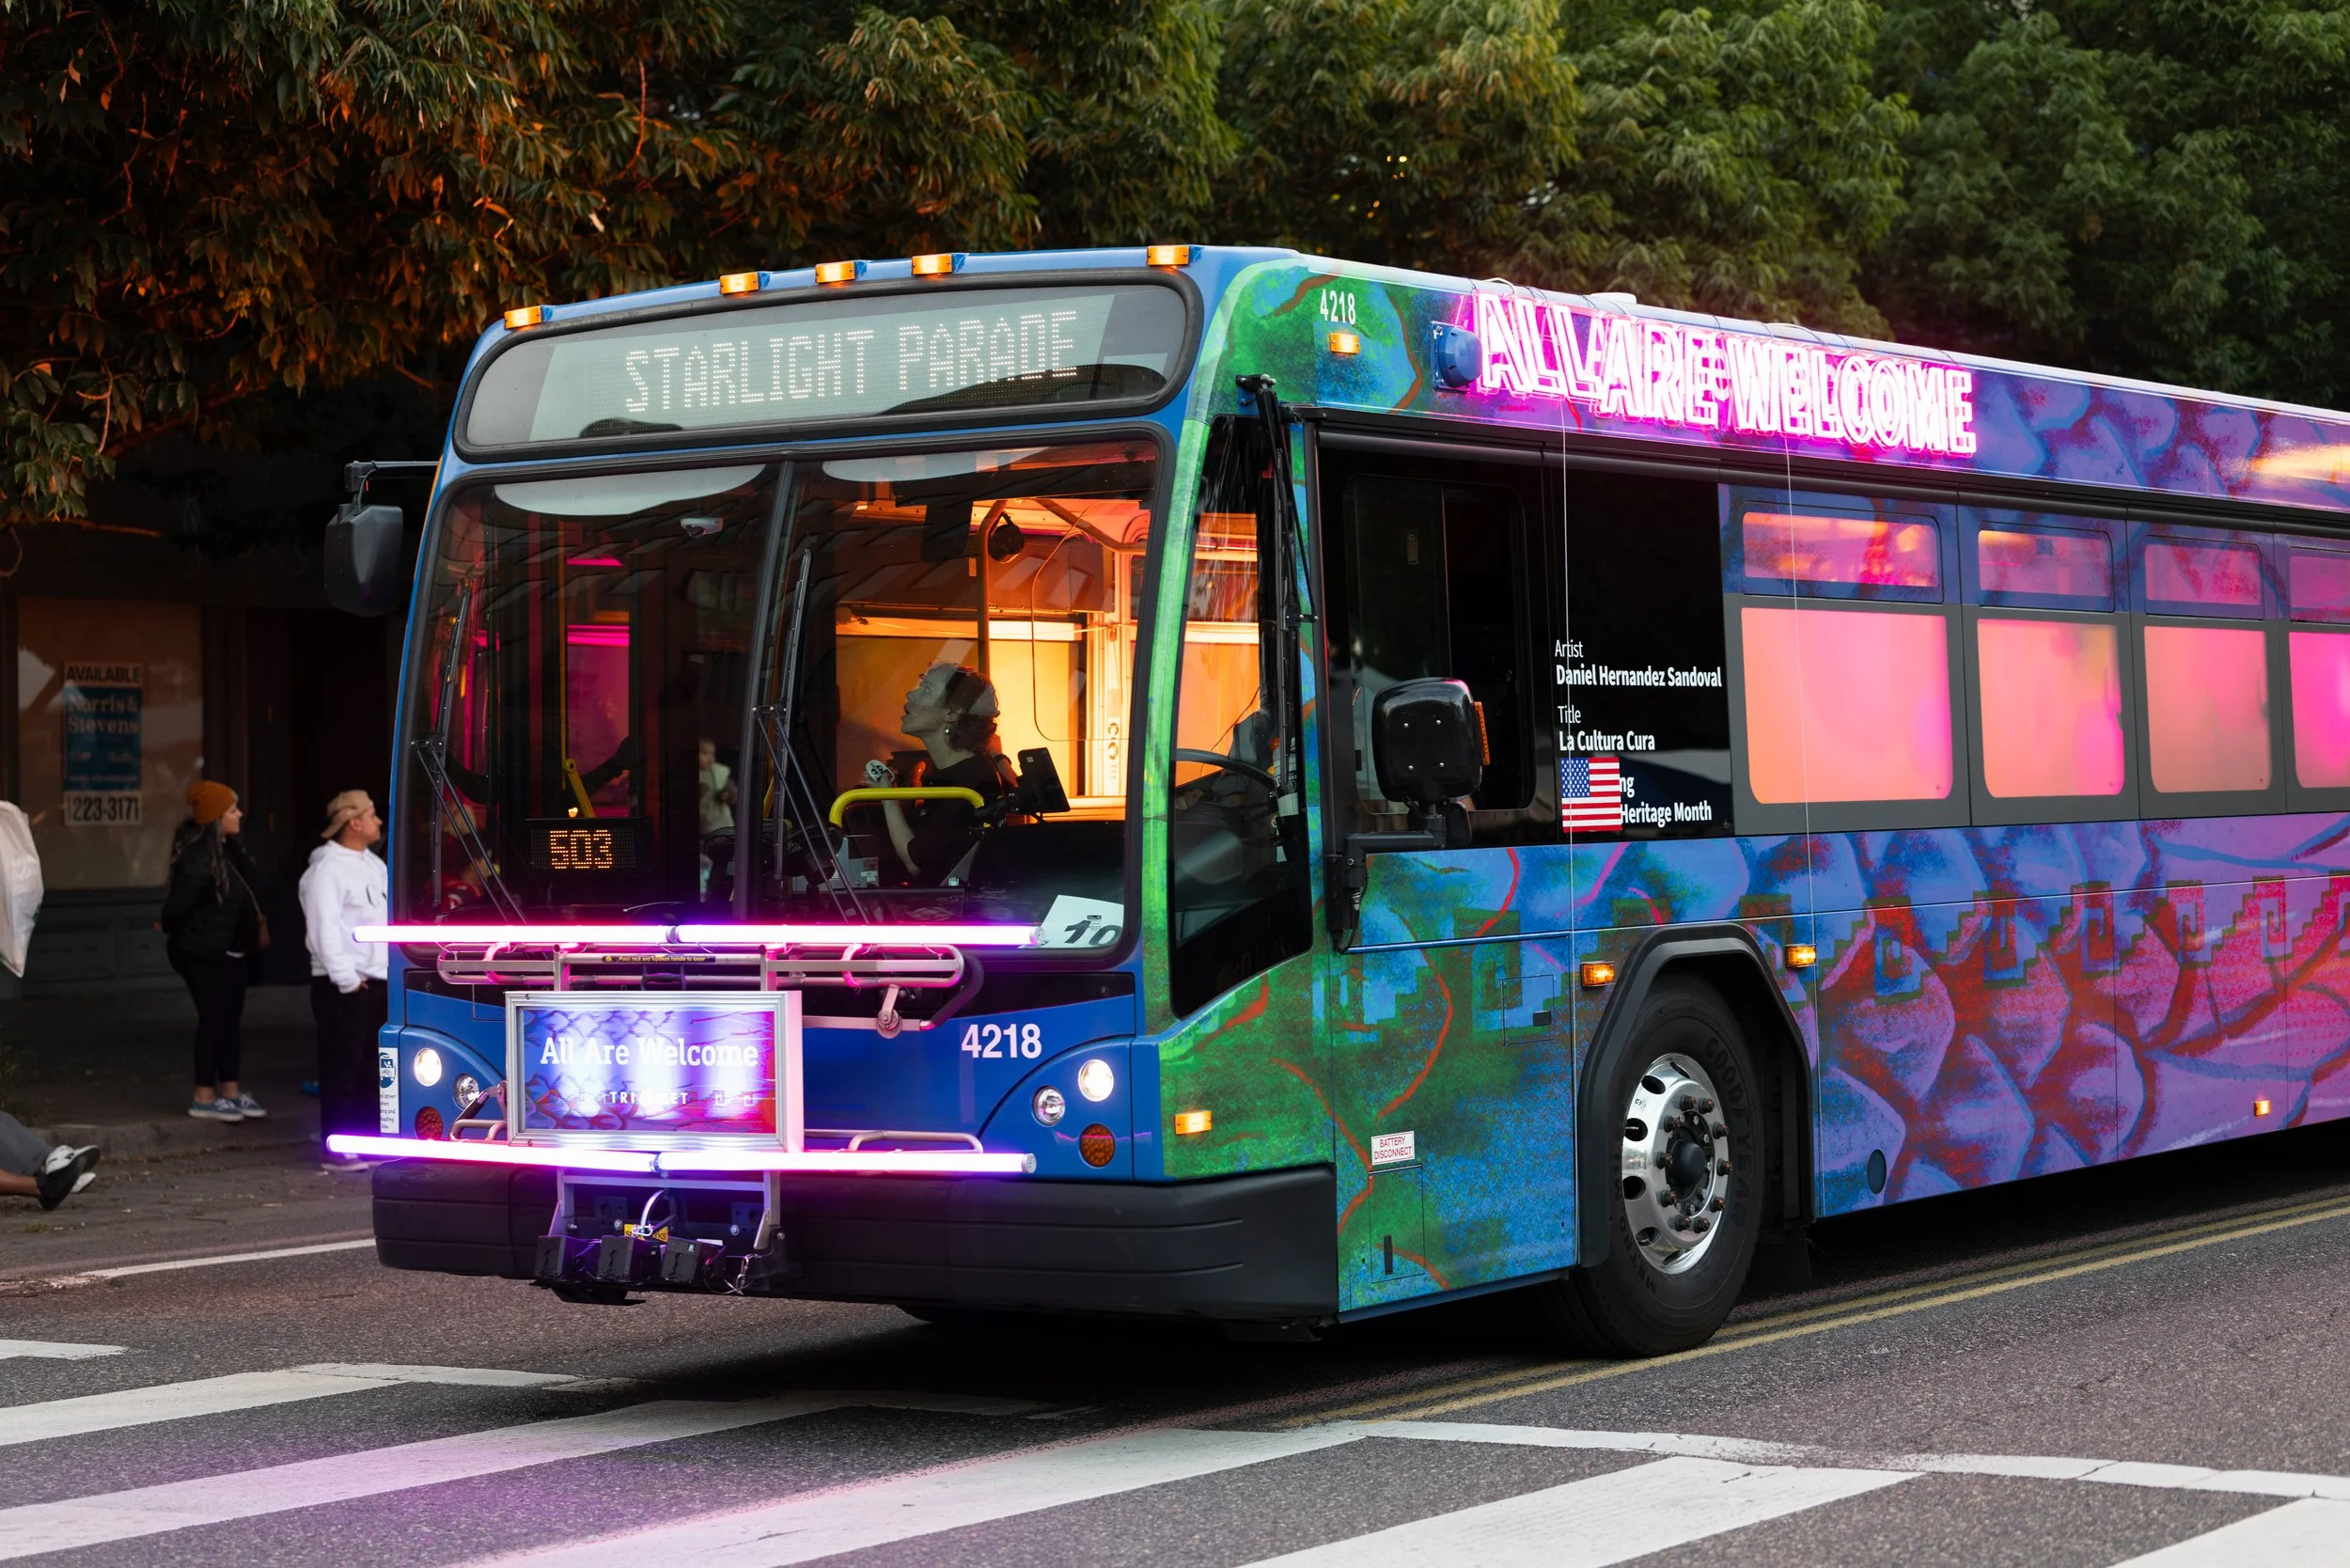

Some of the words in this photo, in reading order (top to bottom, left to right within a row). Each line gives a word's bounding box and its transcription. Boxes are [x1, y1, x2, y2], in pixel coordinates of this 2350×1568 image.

[1320, 289, 1356, 325] 4218
[625, 329, 875, 413] STARLIGHT
[899, 310, 1078, 391] PARADE
[1476, 292, 1604, 401] ALL
[1596, 313, 1720, 429] ARE
[1724, 337, 1977, 455] WELCOME
[1555, 639, 1584, 658] Artist
[66, 666, 140, 682] AVAILABLE
[1556, 663, 1598, 686] Daniel
[1599, 666, 1666, 687] Hernandez
[1667, 666, 1722, 687] Sandoval
[68, 693, 127, 713] Norris
[1558, 704, 1581, 724] Title
[68, 713, 138, 734] Stevens
[1559, 730, 1574, 751] La
[1576, 729, 1624, 751] Cultura
[1626, 730, 1655, 751] Cura
[72, 796, 139, 822] 223-3171
[1620, 802, 1672, 828] Heritage
[1674, 800, 1713, 822] Month
[550, 830, 613, 870] 503
[540, 1036, 576, 1065] All
[583, 1037, 630, 1065] Are
[636, 1036, 759, 1067] Welcome
[961, 1023, 1042, 1059] 4218
[1379, 1136, 1406, 1148] BATTERY
[1704, 1036, 1753, 1229] GOODYEAR
[1374, 1145, 1413, 1160] DISCONNECT
